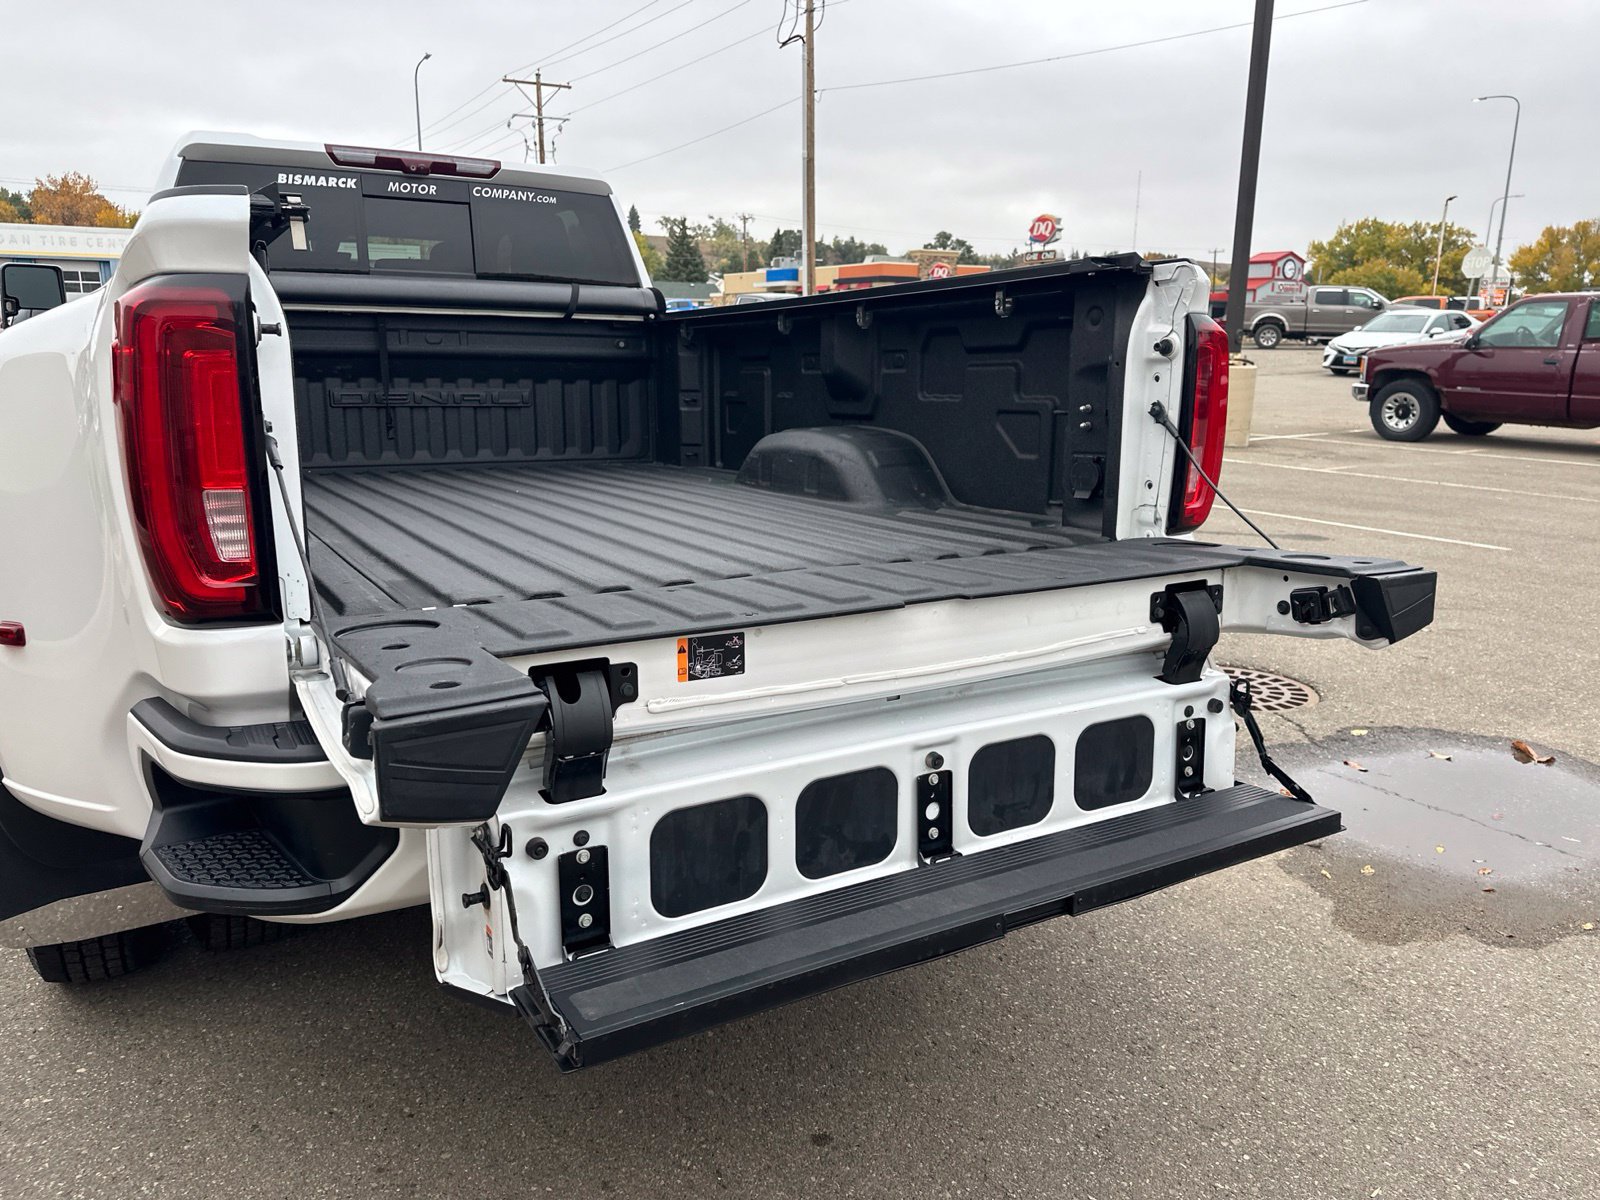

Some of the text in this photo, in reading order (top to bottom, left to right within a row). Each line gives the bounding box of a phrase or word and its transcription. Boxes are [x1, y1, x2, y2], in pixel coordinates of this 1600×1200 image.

[277, 173, 357, 188] BISMARCK
[387, 181, 437, 195] MOTOR
[1033, 220, 1052, 236] DQ
[39, 235, 78, 247] TIRE
[1464, 256, 1490, 269] STOP
[933, 267, 948, 278] DQ
[332, 391, 530, 405] DENALI
